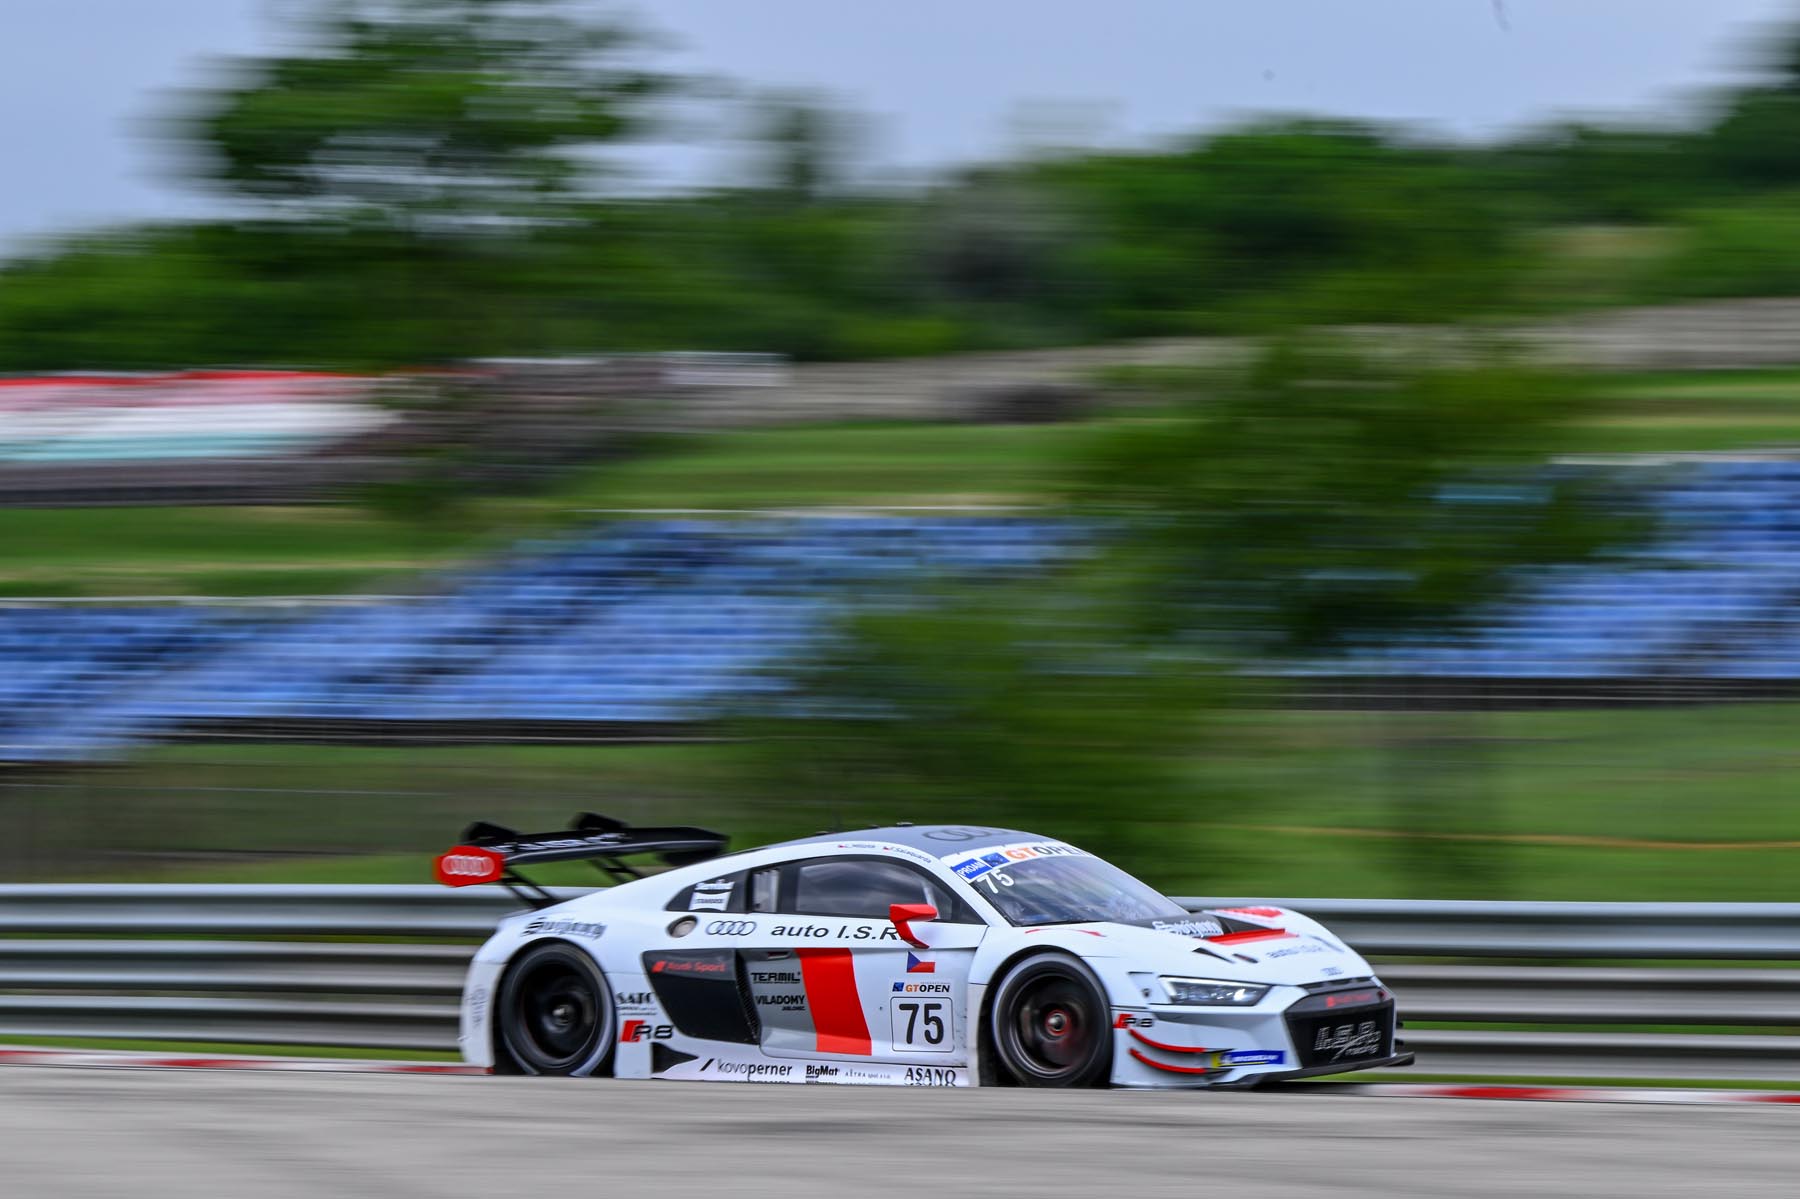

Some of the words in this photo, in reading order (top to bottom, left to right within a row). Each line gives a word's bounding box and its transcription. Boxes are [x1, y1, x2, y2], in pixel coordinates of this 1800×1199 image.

[977, 870, 1014, 894] 75
[771, 925, 829, 938] auto
[695, 962, 725, 972] Sport
[750, 972, 801, 981] TERMIL
[905, 984, 950, 992] GTOPEN
[756, 995, 805, 1005] VILADOMY
[899, 1003, 944, 1044] 75
[632, 1025, 673, 1040] R8
[717, 1059, 792, 1079] kovoperner
[806, 1065, 838, 1078] BigMat
[904, 1067, 956, 1083] ASANO
